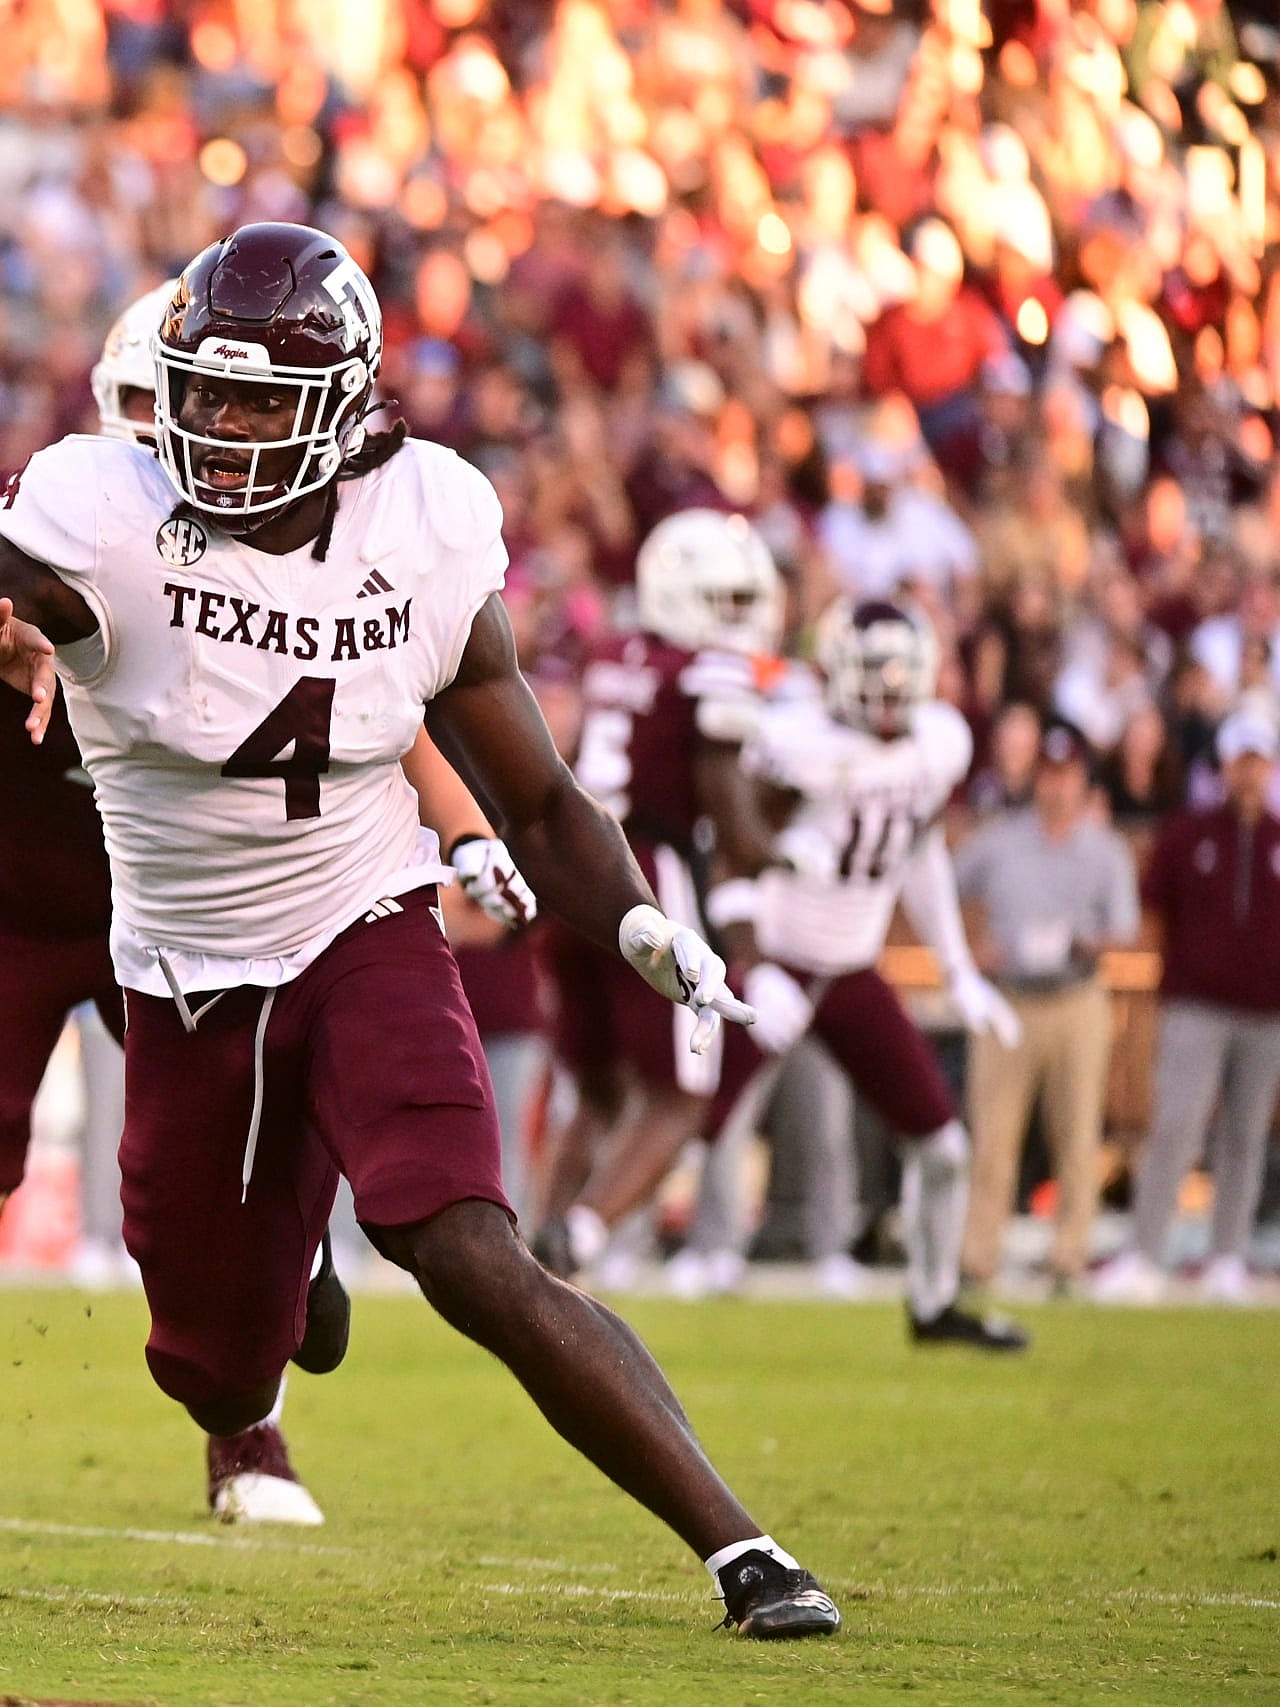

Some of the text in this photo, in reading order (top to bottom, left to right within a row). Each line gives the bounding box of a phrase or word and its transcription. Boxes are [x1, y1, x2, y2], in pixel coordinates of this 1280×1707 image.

[213, 344, 249, 360] Aggies
[159, 519, 204, 565] SEC
[163, 582, 412, 662] TEXAS A&M
[220, 676, 337, 822] 4
